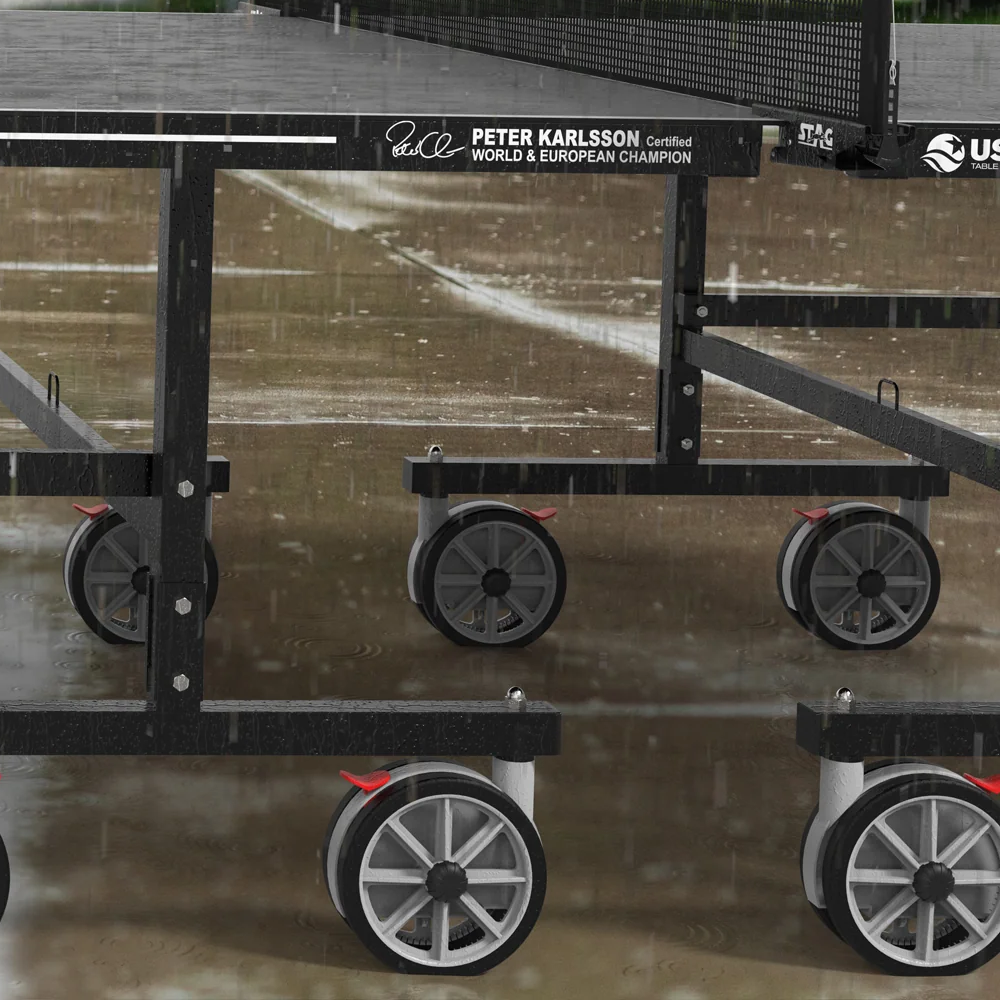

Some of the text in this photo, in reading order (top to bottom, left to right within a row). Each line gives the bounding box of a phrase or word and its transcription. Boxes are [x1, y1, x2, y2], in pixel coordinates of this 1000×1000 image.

[472, 128, 533, 146] PETER
[538, 129, 640, 147] KARLSSON
[646, 136, 692, 147] Certified
[798, 122, 833, 150] STAG
[472, 149, 692, 164] WORLD & EUROPEAN CHAMPION
